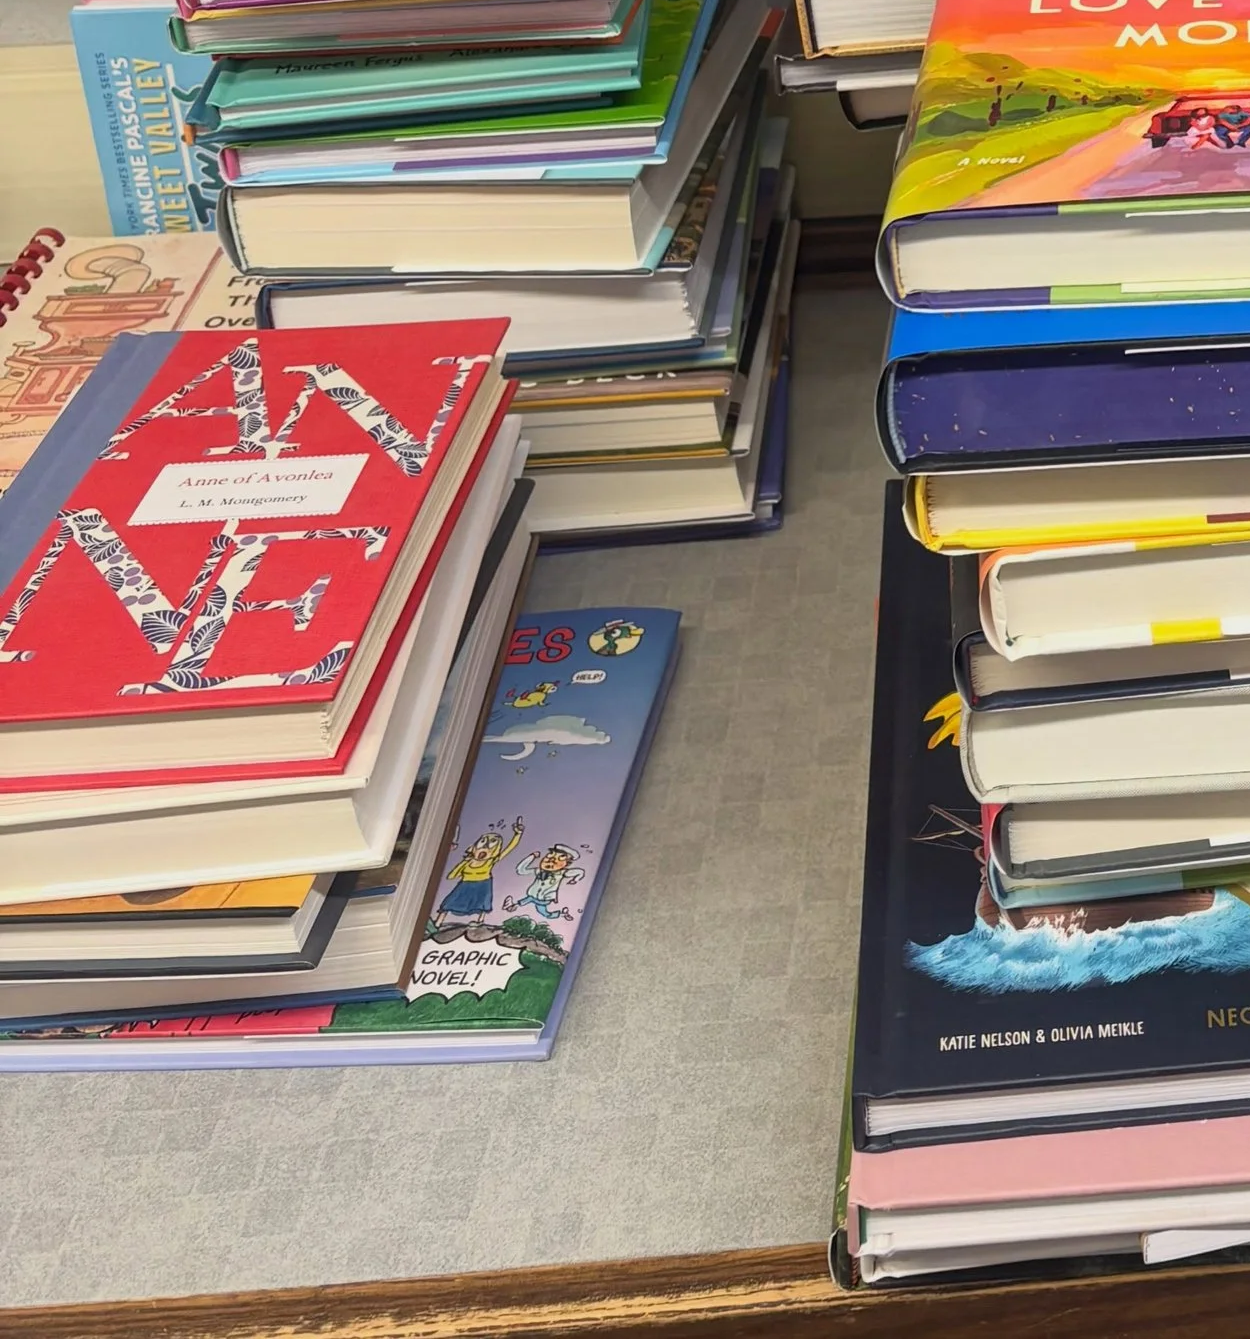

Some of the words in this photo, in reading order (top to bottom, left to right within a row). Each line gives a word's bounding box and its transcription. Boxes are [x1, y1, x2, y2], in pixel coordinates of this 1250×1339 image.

[95, 51, 119, 89] SERIES
[276, 60, 355, 74] Maureen
[110, 56, 145, 150] PASCAL'S
[131, 58, 179, 155] VALLEY
[102, 92, 126, 164] BESTSELLING
[957, 157, 970, 166] A
[977, 155, 1026, 166] Novel
[119, 168, 133, 198] TIMES
[130, 154, 161, 235] RANCINE
[152, 165, 193, 233] WEET
[227, 275, 265, 287] Fro
[204, 315, 256, 329] Ove
[178, 476, 229, 488] Anne
[233, 472, 257, 485] of
[258, 469, 334, 484] Avonlea
[179, 499, 194, 508] L.
[197, 498, 217, 507] M.
[219, 493, 309, 507] Montgomery
[504, 625, 576, 665] ES
[575, 672, 605, 682] HELP!
[421, 949, 512, 967] GRAPHIC
[411, 969, 482, 988] NOVEL!
[940, 1035, 977, 1051] KATIE
[981, 1031, 1031, 1048] NELSON
[1036, 1030, 1046, 1044] &
[1050, 1026, 1094, 1043] OLIVIA
[1098, 1021, 1146, 1038] MEIKLE
